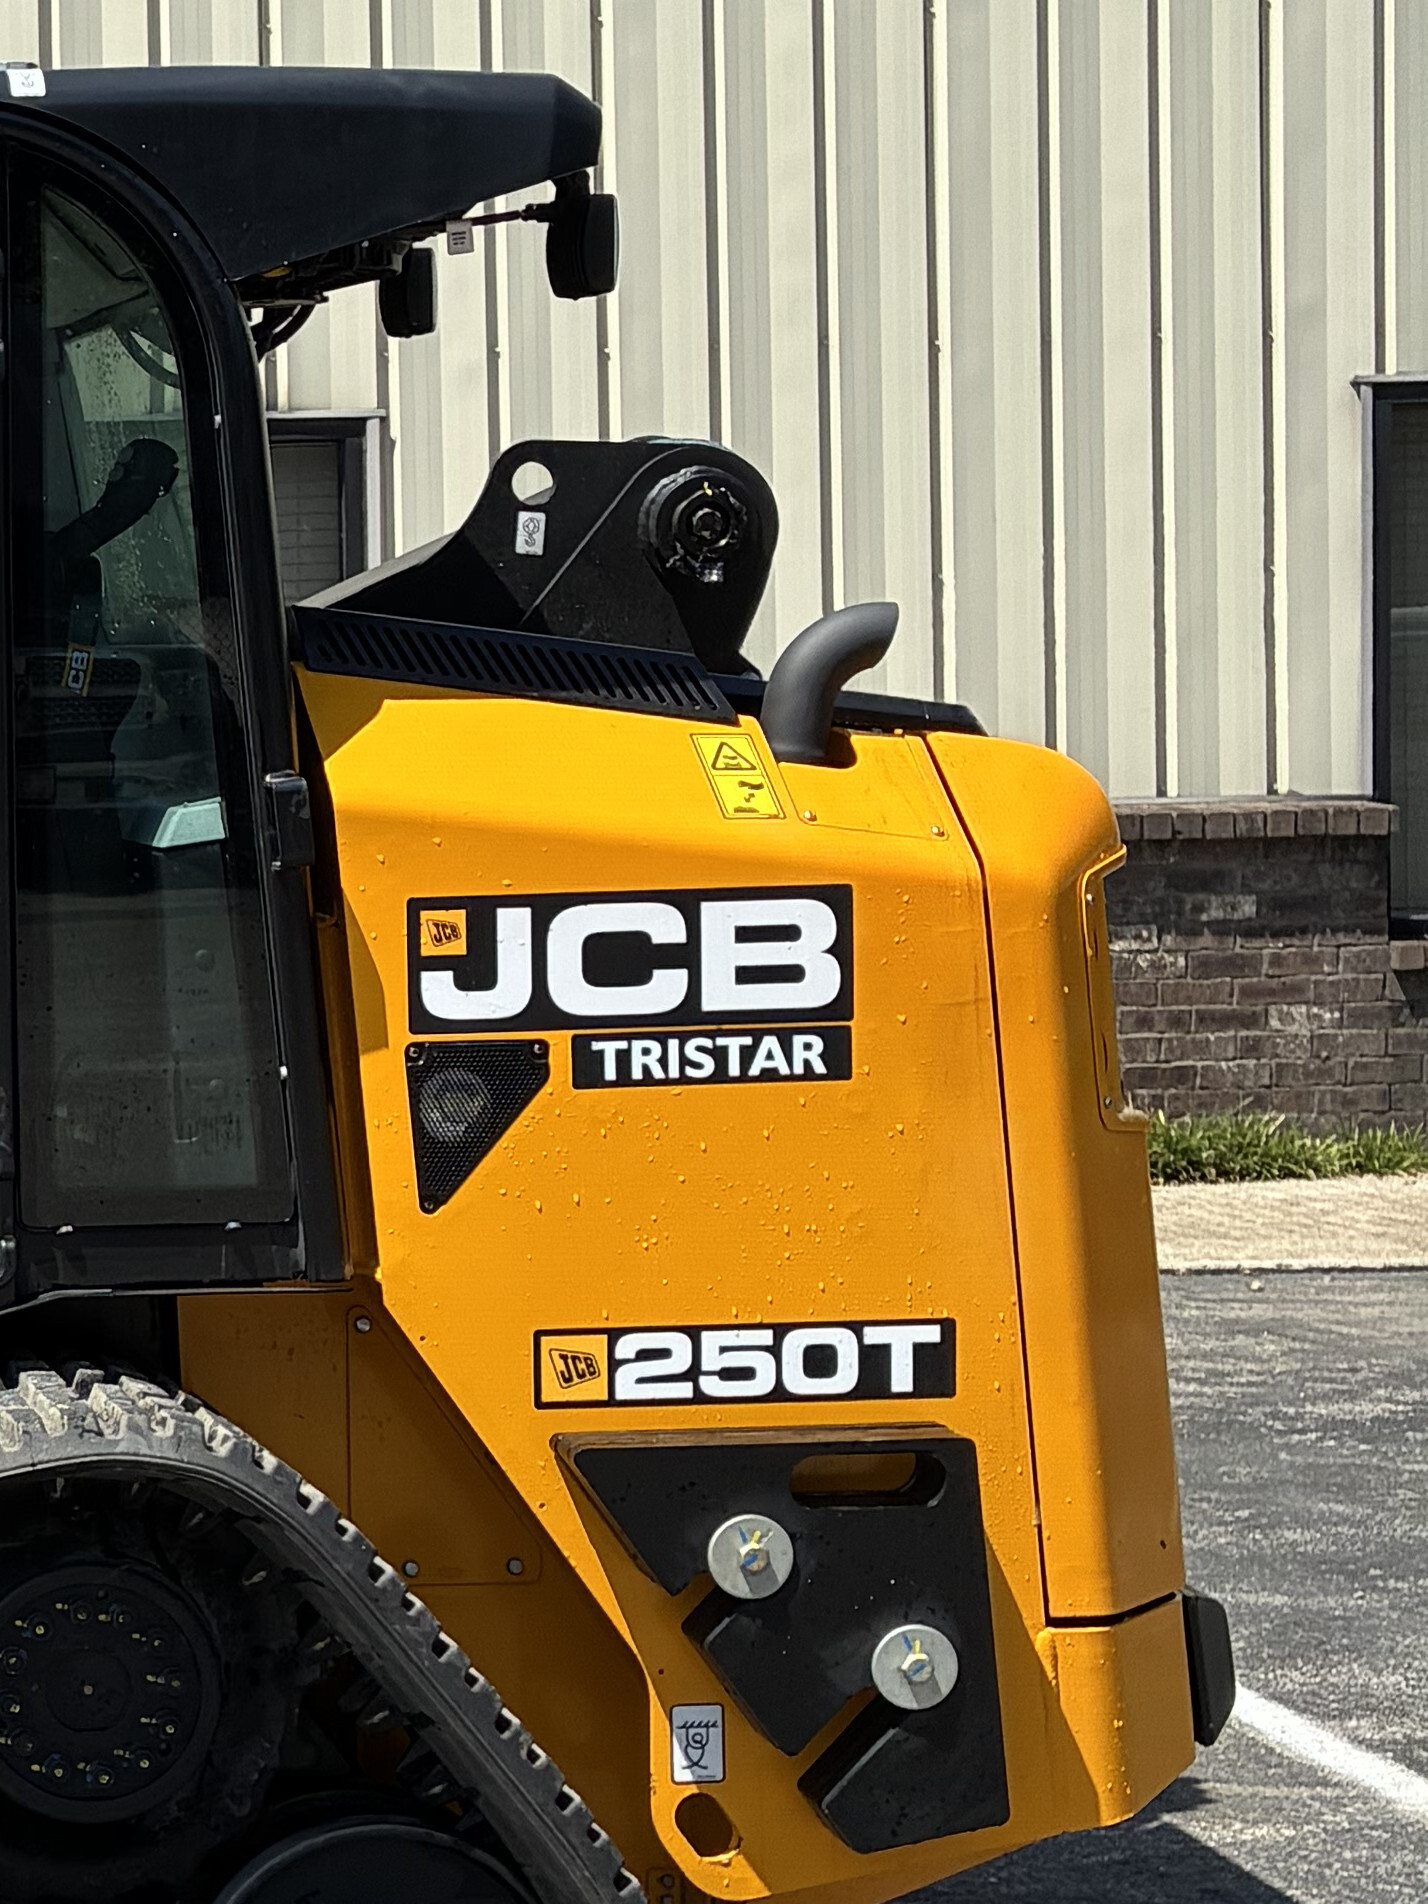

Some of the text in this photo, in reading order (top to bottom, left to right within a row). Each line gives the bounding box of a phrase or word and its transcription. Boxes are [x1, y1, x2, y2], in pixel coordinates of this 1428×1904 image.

[420, 898, 842, 1020] JCB
[432, 922, 459, 943] JCB
[590, 1034, 828, 1081] TRISTAR
[559, 1324, 942, 1401] JCB 250T
